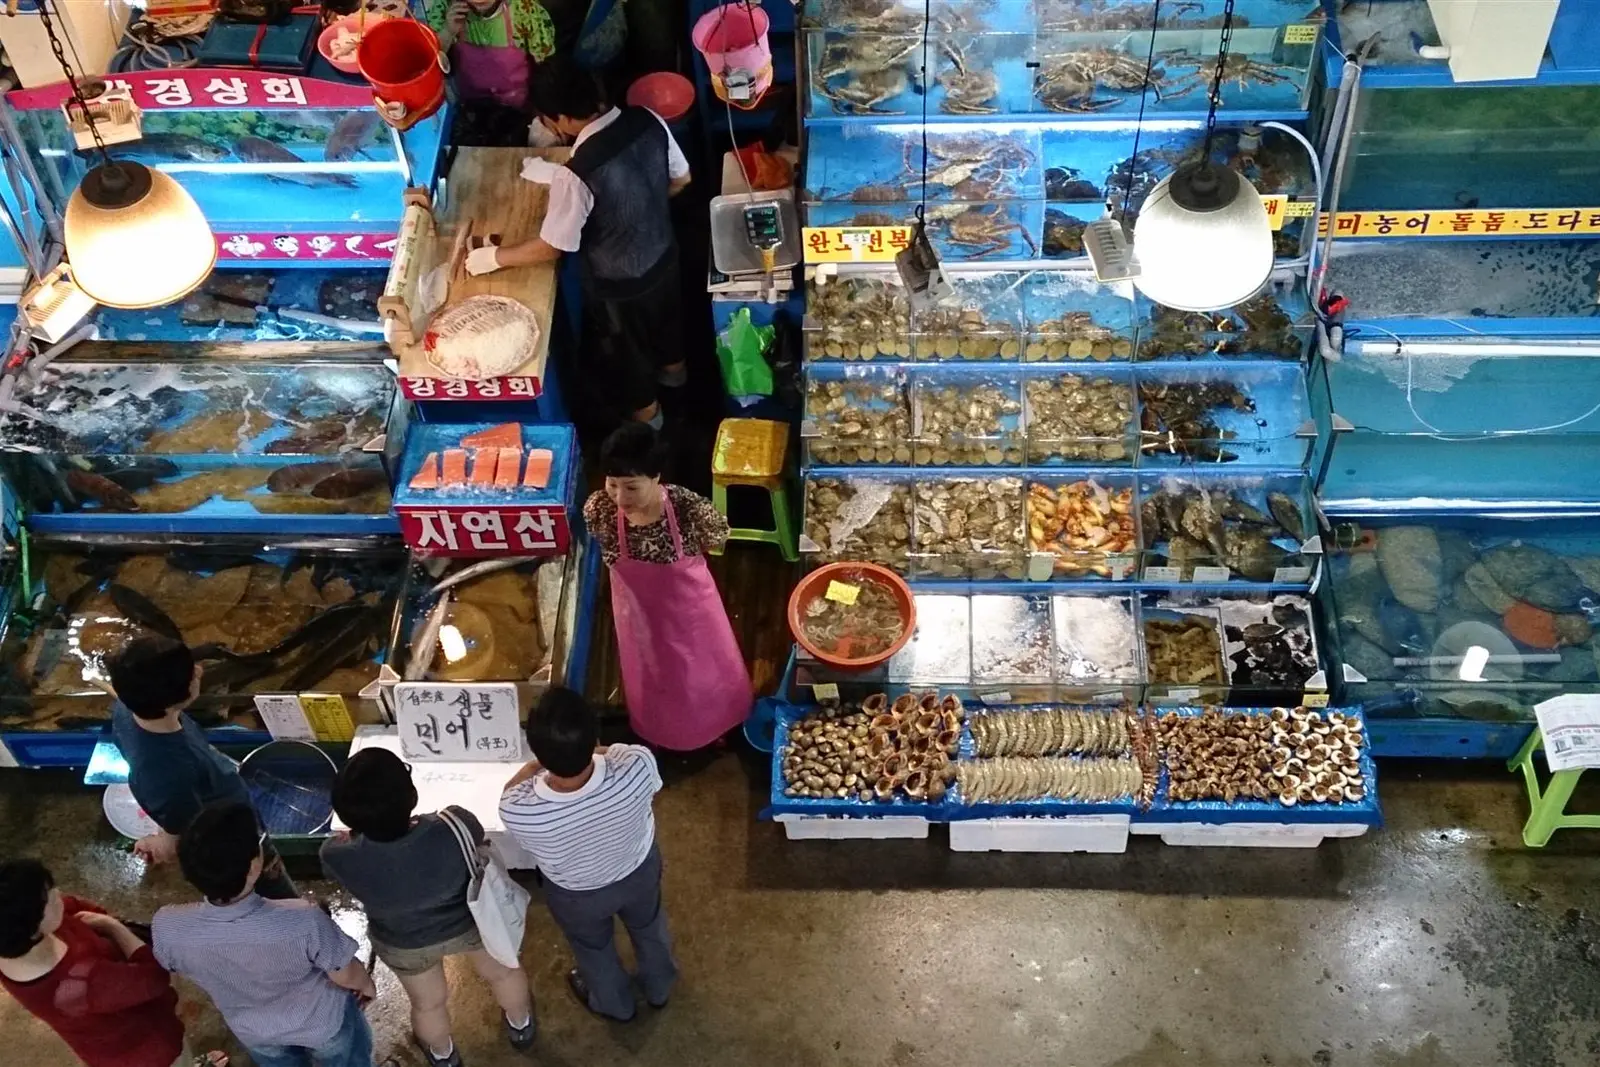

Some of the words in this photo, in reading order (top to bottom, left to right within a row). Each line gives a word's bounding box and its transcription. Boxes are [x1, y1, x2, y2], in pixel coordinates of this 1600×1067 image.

[407, 377, 535, 397] 강경상회
[411, 509, 557, 551] 자연산
[414, 713, 469, 755] 민어
